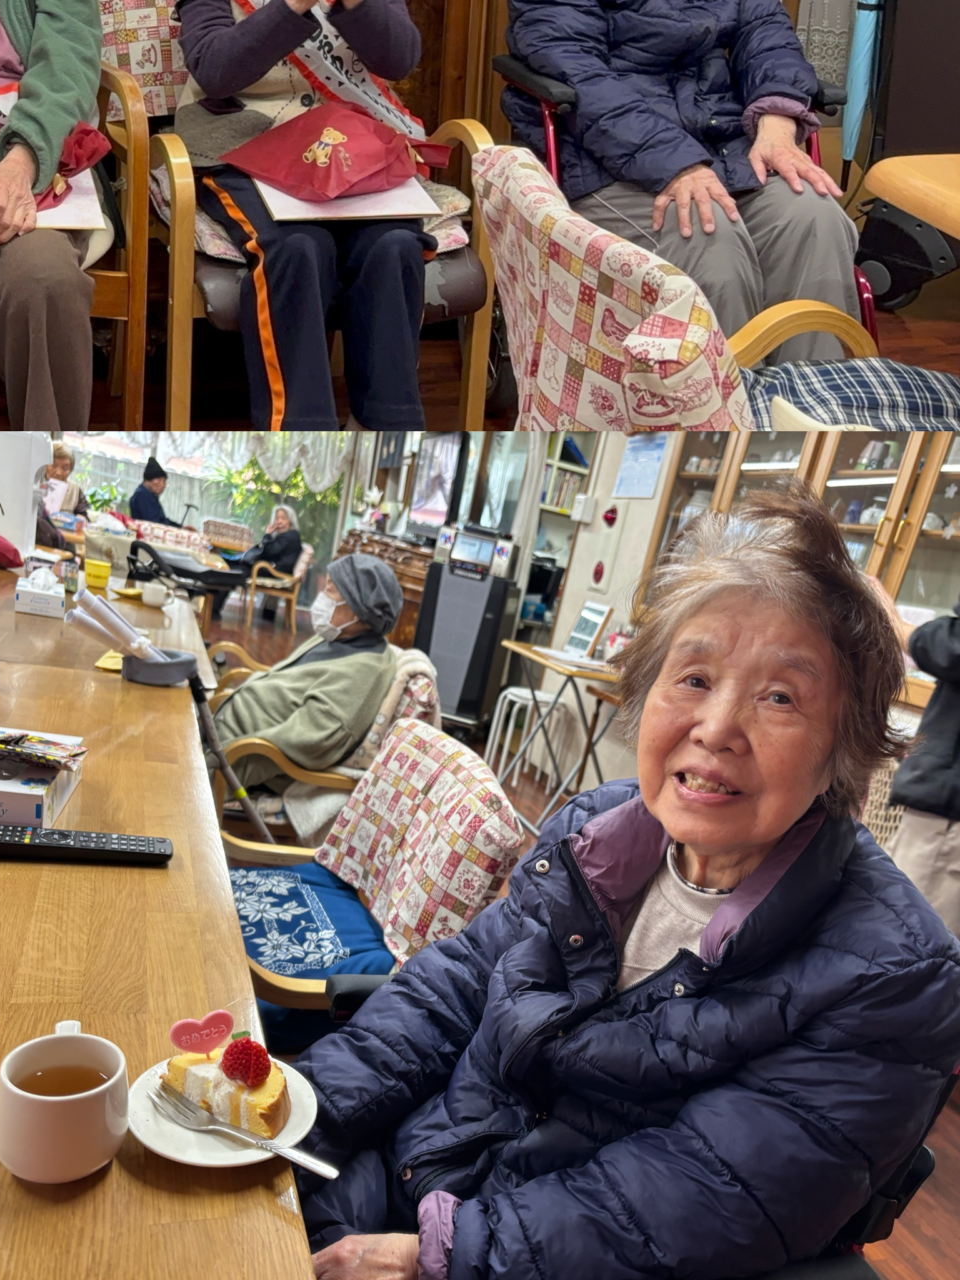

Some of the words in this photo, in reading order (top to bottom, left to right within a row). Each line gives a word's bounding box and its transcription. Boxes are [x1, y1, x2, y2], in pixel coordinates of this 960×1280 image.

[180, 1024, 228, 1047] おめでとう
